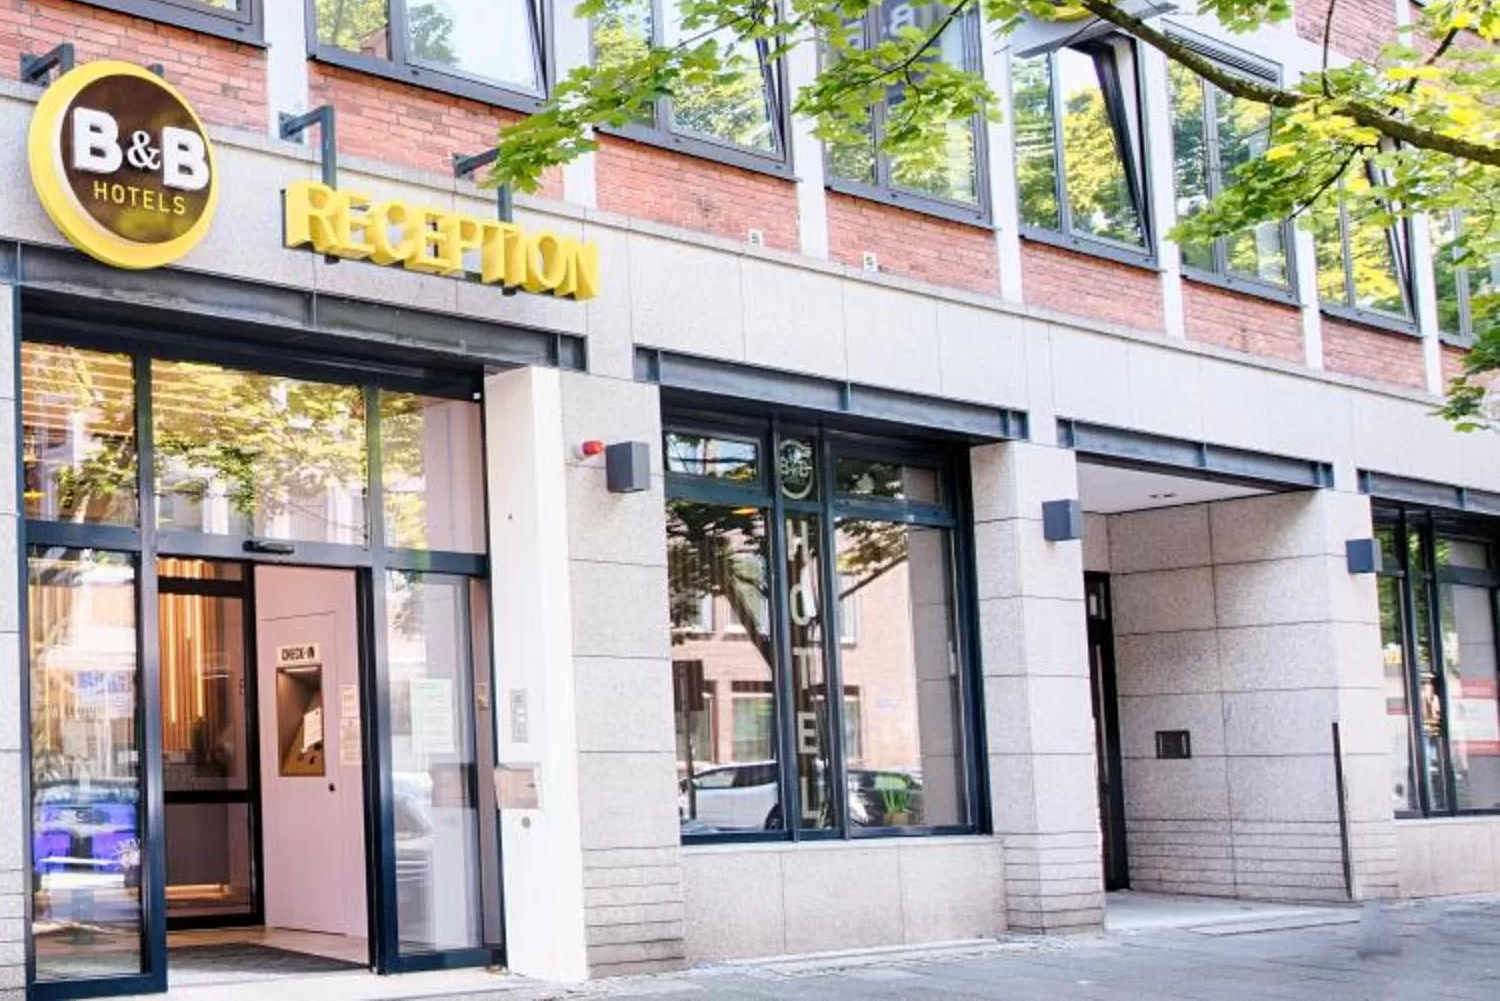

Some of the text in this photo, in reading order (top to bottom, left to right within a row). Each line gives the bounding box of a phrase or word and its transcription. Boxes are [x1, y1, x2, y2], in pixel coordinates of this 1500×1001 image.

[72, 106, 209, 191] B&B
[93, 180, 186, 216] HOTELS
[281, 179, 598, 301] RECEPTION
[786, 517, 824, 821] HOTEL
